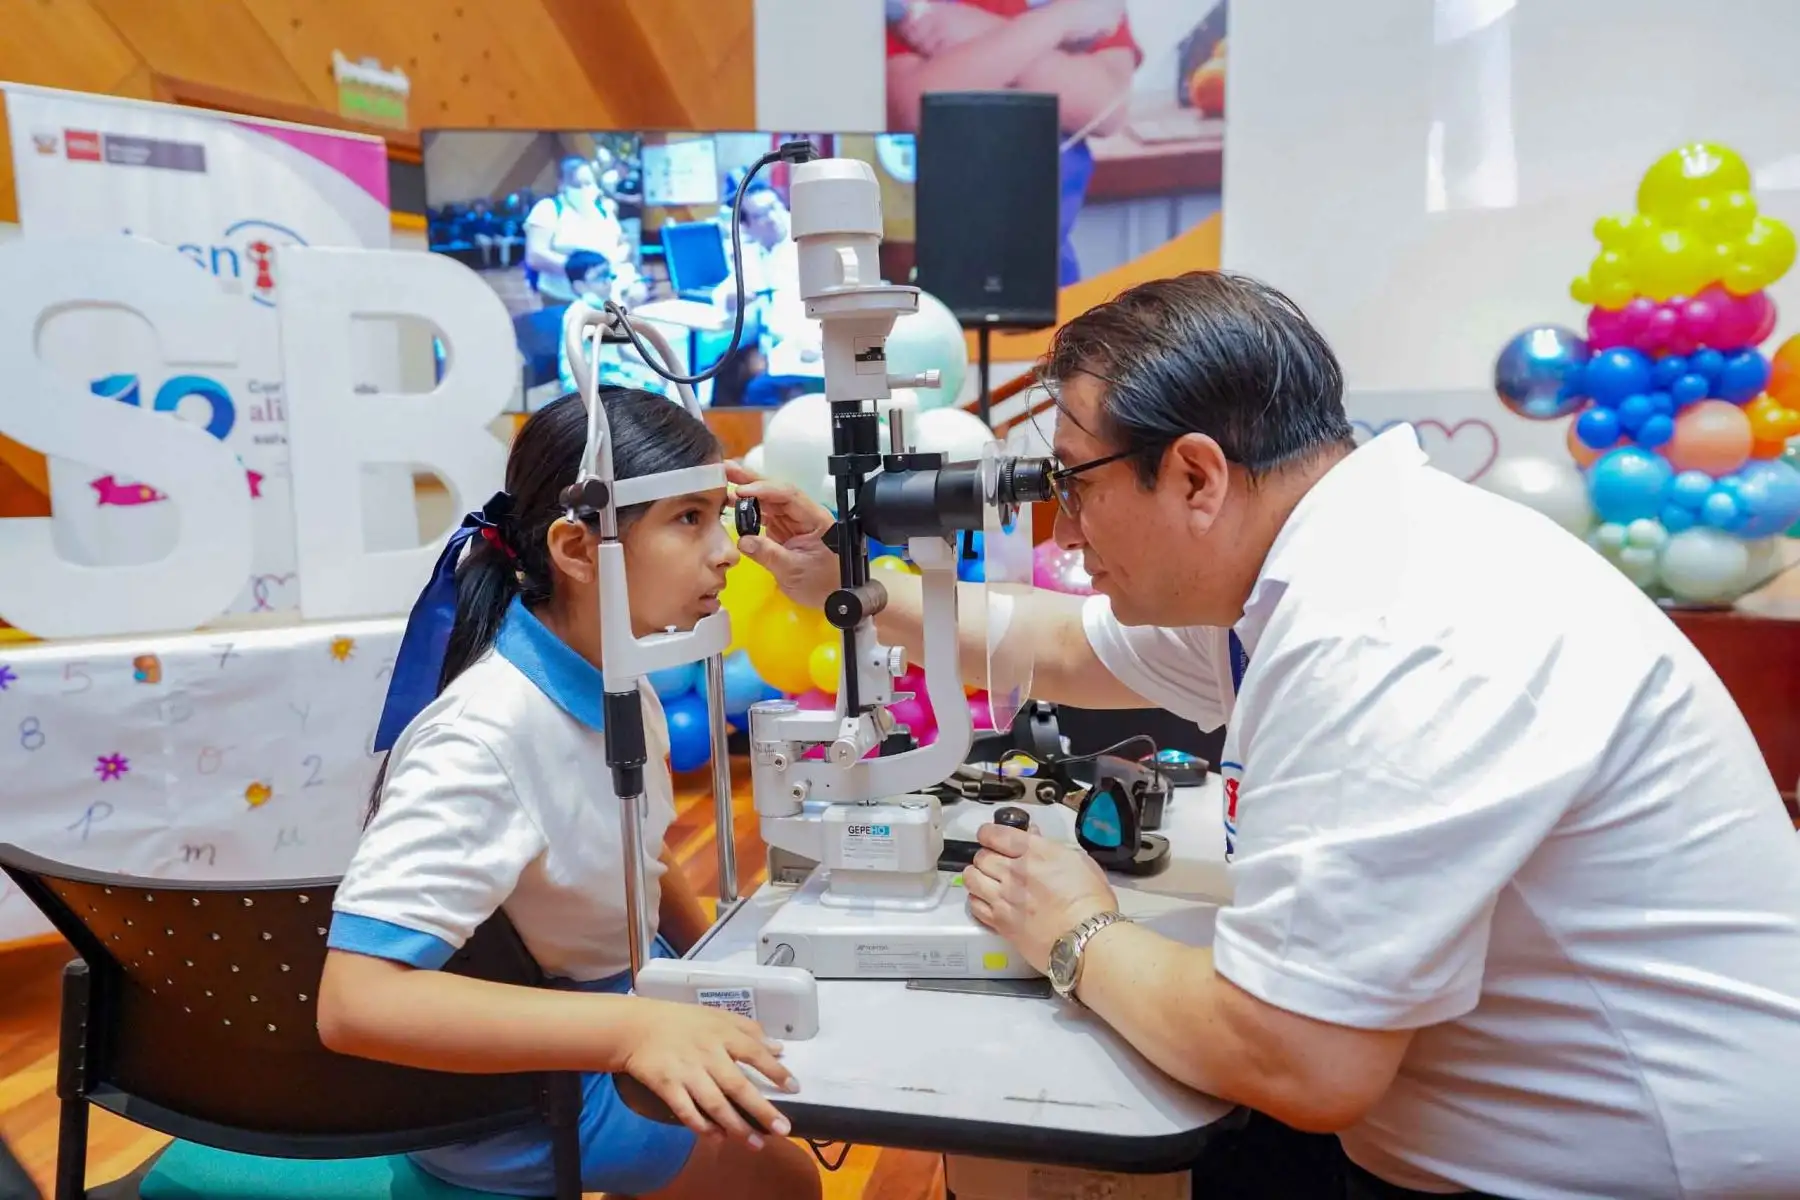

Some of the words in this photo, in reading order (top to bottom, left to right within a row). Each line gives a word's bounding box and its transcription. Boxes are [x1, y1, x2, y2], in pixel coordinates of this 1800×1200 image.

[61, 661, 93, 695] 5
[18, 716, 46, 751] 8
[301, 754, 325, 788] 2
